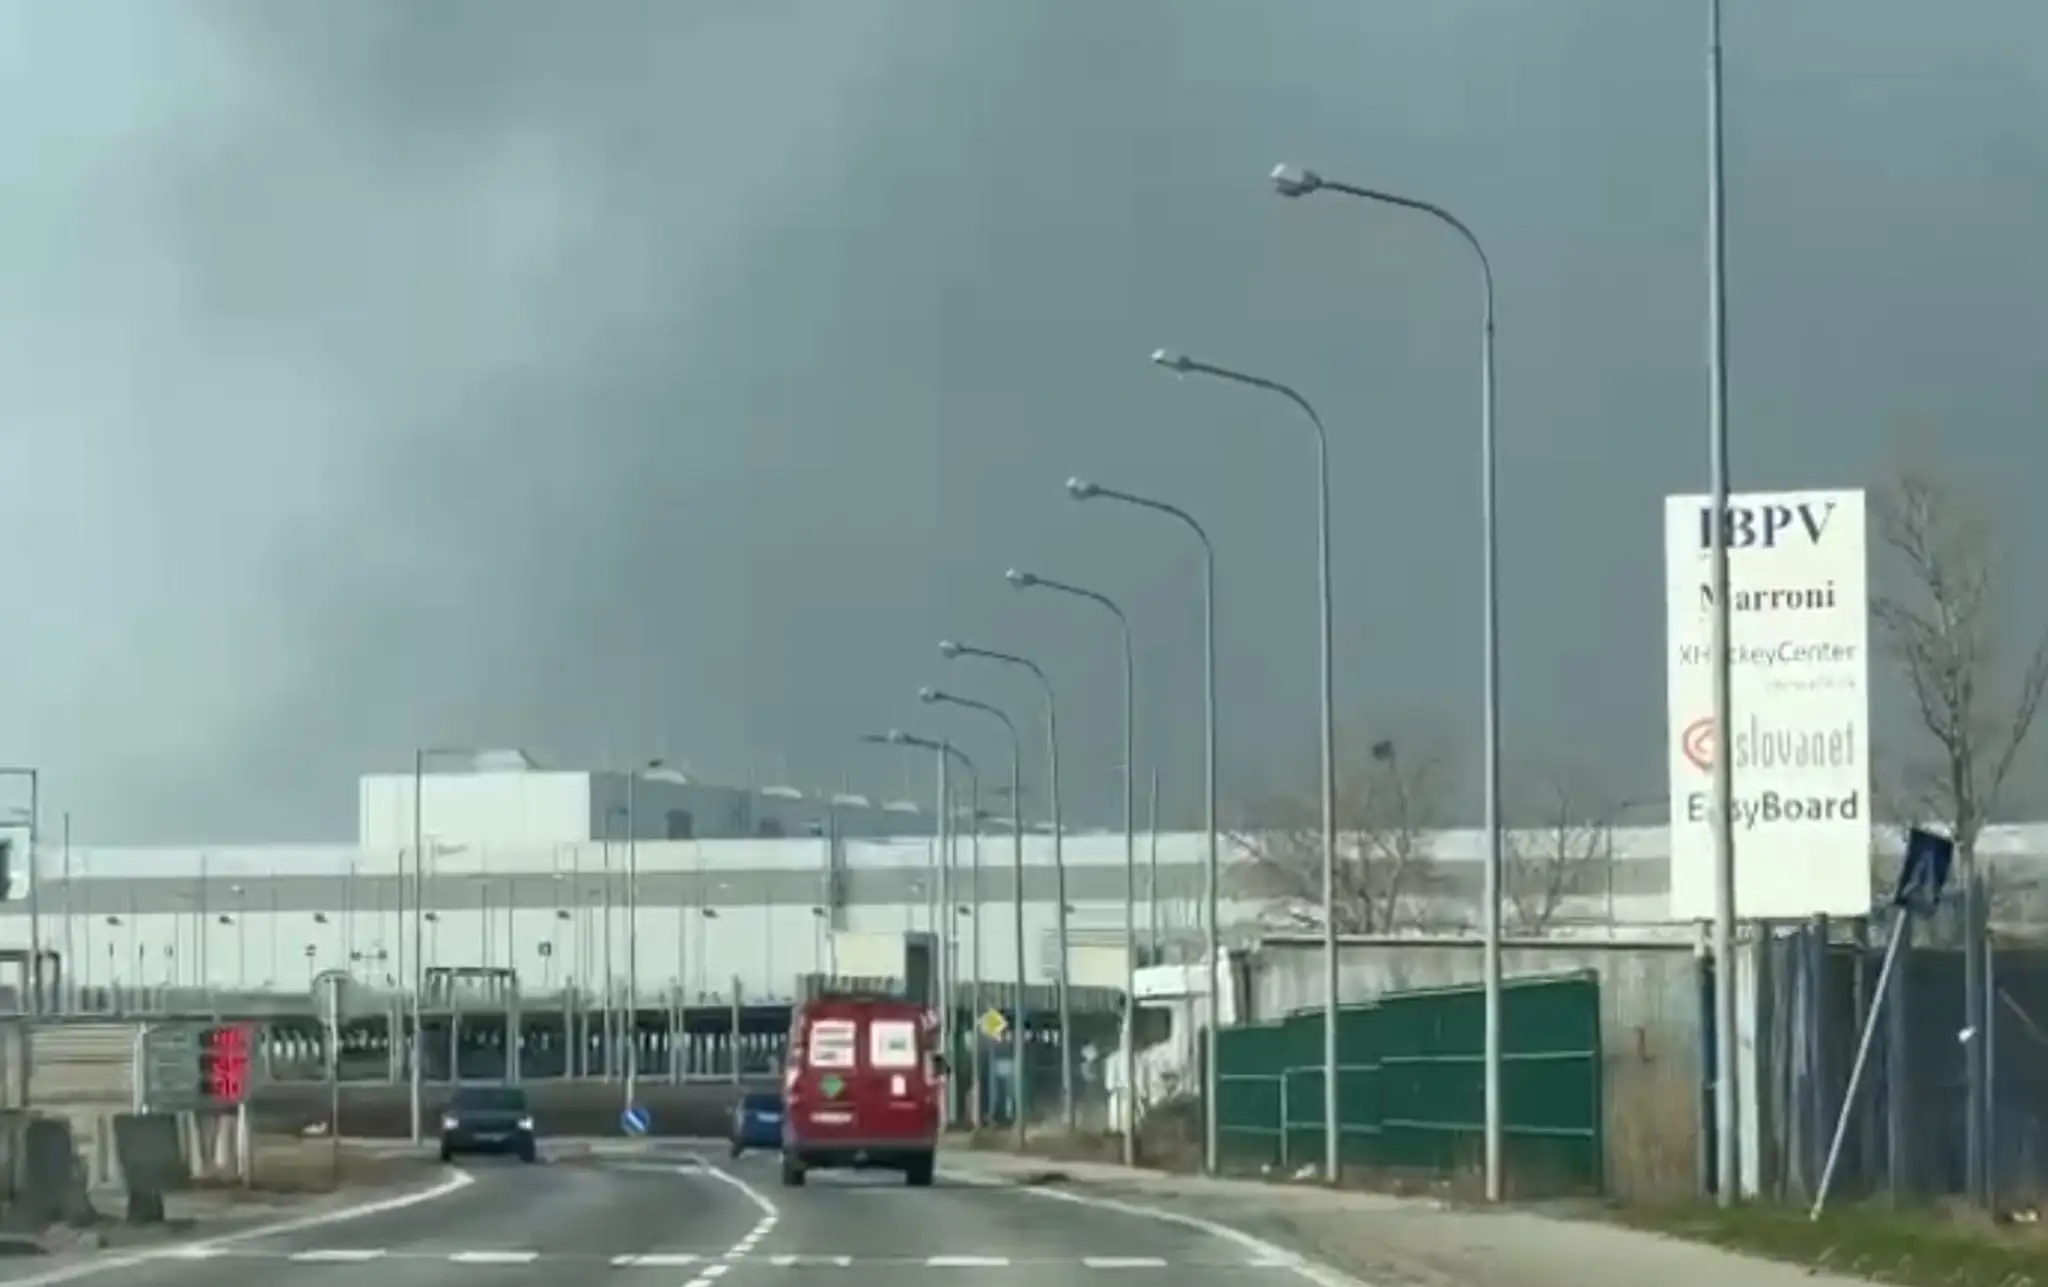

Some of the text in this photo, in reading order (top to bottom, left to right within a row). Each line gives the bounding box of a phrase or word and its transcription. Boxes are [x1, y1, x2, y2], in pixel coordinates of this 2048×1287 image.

[1679, 640, 1856, 668] XHckeyCenter
[1735, 712, 1854, 768] slovanet
[1688, 789, 1859, 830] EsyBoard
